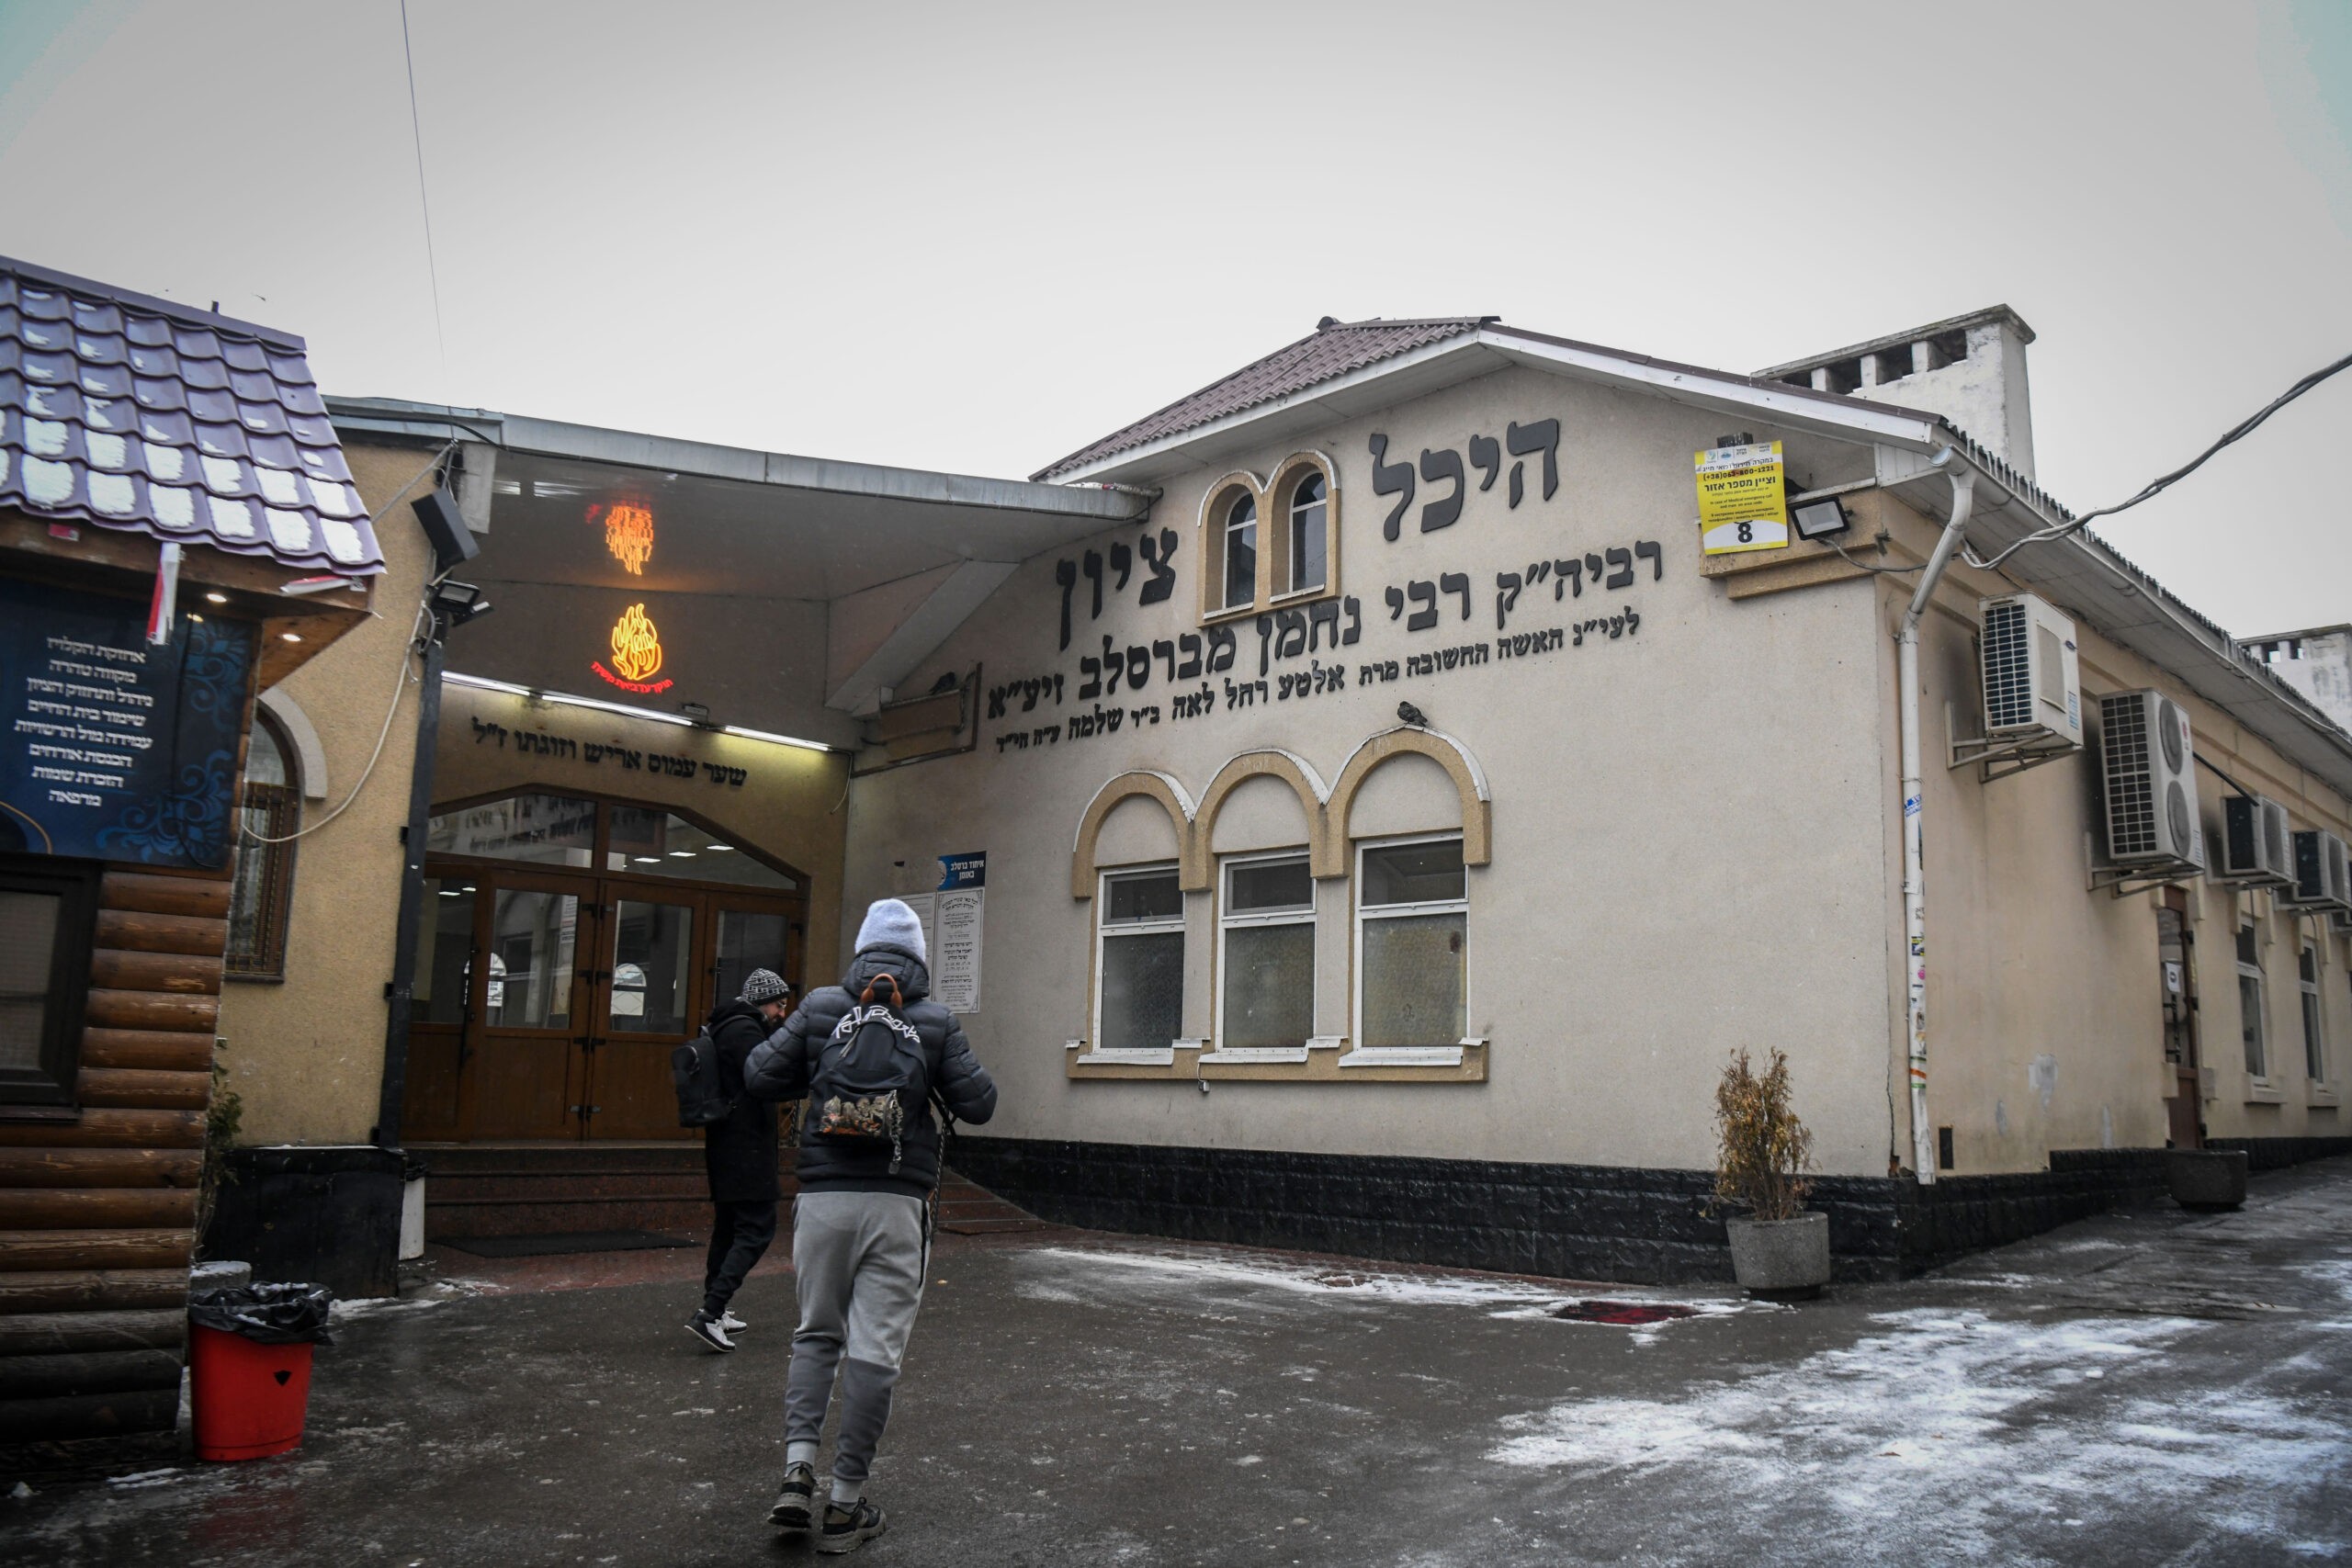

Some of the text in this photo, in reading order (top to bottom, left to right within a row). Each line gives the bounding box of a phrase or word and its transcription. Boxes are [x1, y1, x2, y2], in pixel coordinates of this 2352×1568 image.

[1704, 482, 1725, 492] אזור
[1727, 479, 1753, 489] מספר
[1057, 418, 1559, 650] היכל ציון
[1737, 522, 1753, 543] 8
[1385, 572, 1470, 632] רבי
[1497, 540, 1662, 630] רביה"ק
[1256, 594, 1362, 677] נחמן
[1498, 628, 1563, 659] האשה
[1079, 626, 1236, 700] מברסלב
[1359, 660, 1398, 685] מרת
[1407, 642, 1488, 678] החשובה
[1224, 677, 1268, 710] רחל
[1278, 660, 1344, 700] אלטע
[73, 705, 101, 721] בית
[1172, 682, 1215, 720] לאה
[1069, 703, 1124, 740] שלמה
[648, 753, 697, 779] עמוס
[702, 761, 748, 786] שער
